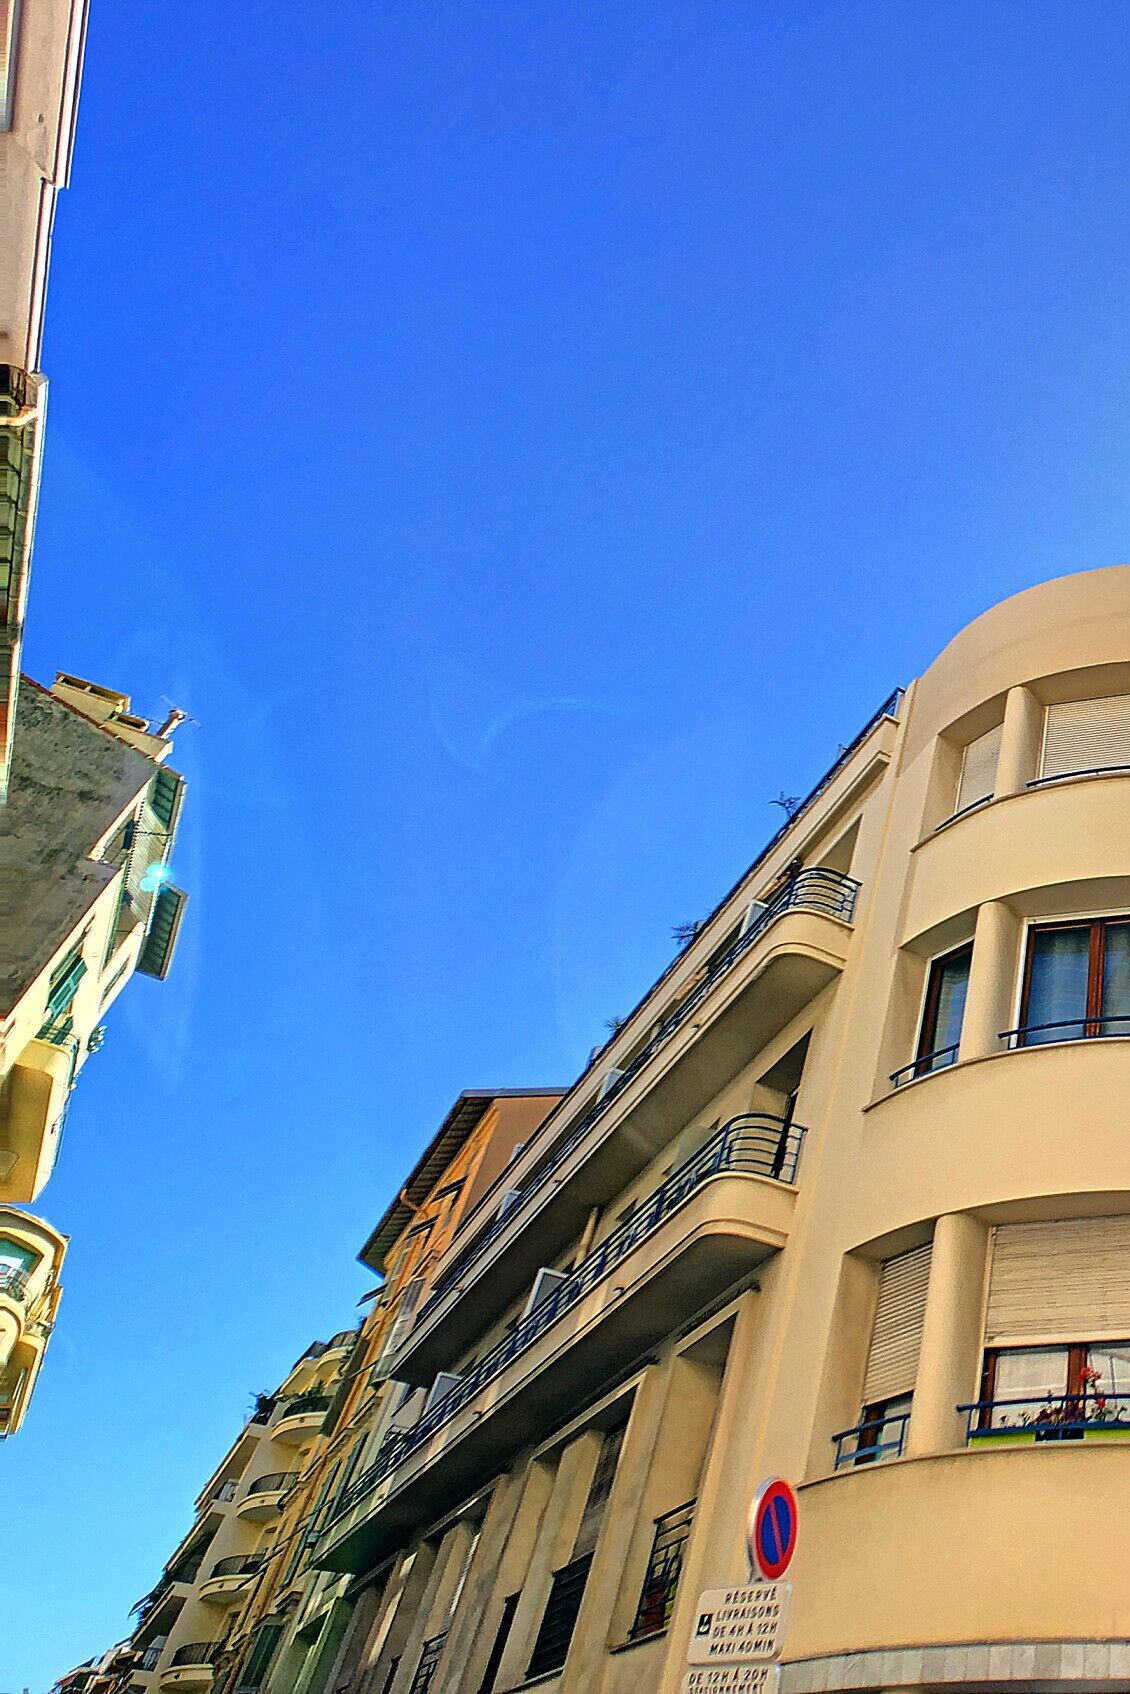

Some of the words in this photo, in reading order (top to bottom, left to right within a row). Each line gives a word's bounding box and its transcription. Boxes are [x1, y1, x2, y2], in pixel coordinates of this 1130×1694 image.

[724, 1586, 777, 1604] RÉSERVÉ
[716, 1604, 781, 1621] LIVRAISONS
[713, 1625, 726, 1639] DE
[729, 1623, 745, 1637] 4H
[757, 1621, 778, 1635] 12H
[709, 1642, 736, 1656] MAXI
[688, 1672, 704, 1685] DE
[708, 1670, 730, 1684] 12H
[744, 1667, 769, 1681] 20H
